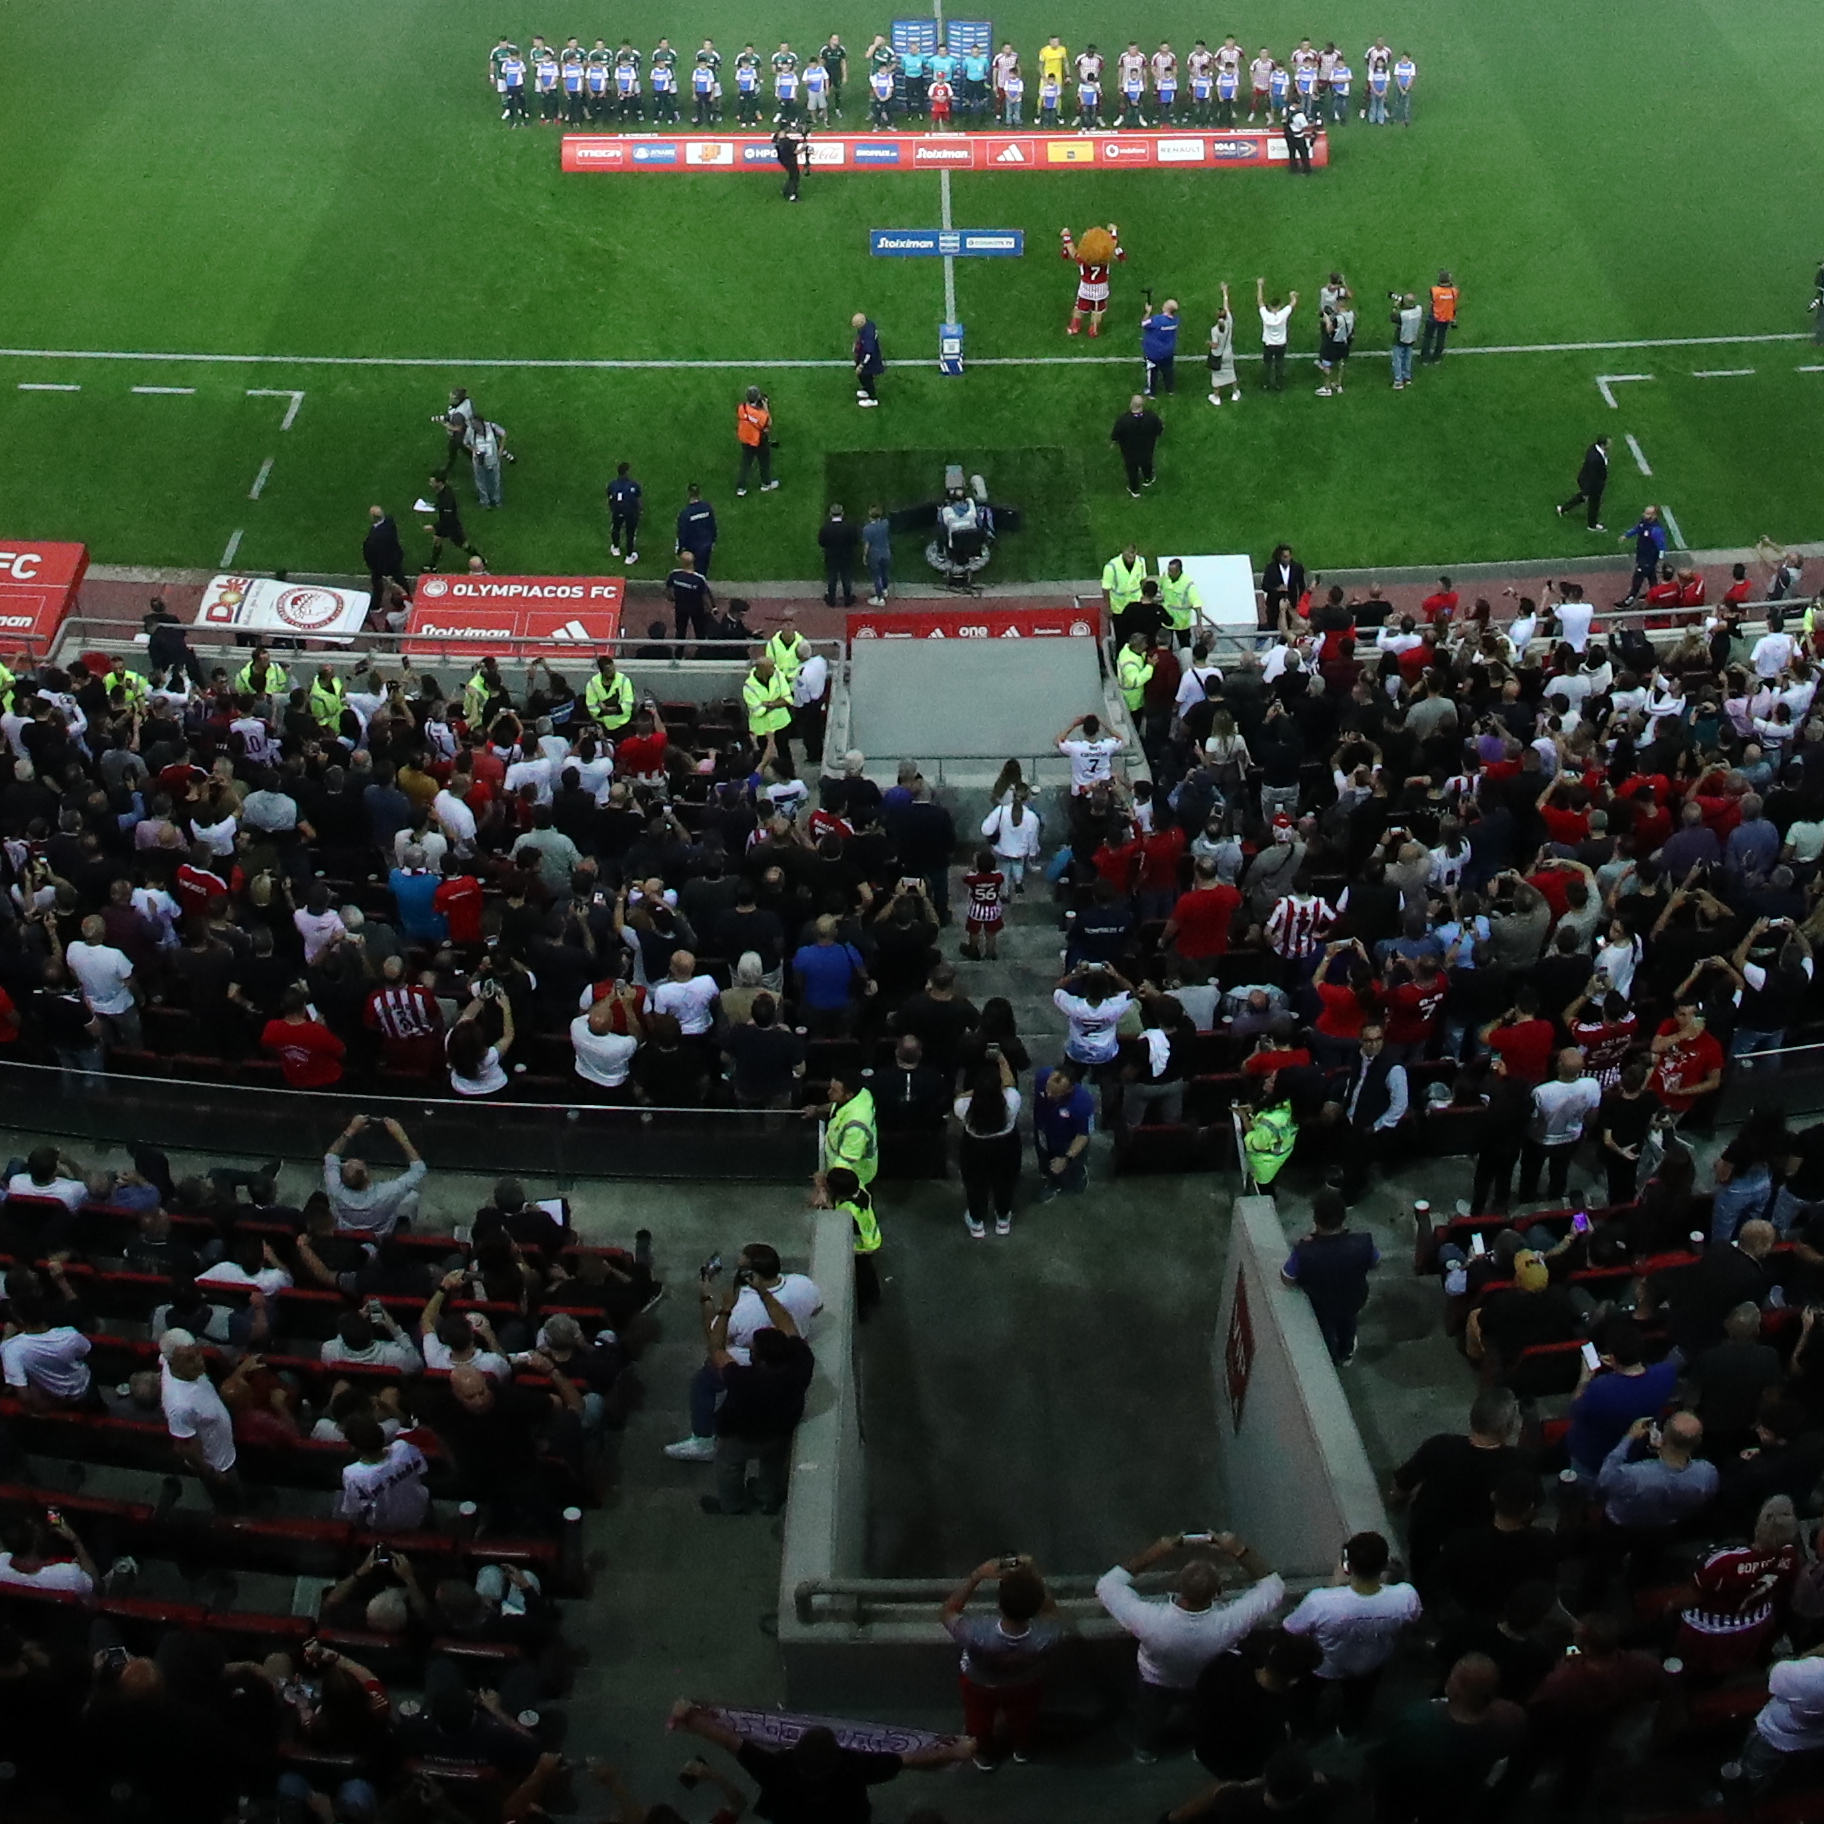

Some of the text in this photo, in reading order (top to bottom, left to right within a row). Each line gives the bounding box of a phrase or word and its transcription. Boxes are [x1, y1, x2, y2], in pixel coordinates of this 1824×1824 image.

[916, 148, 971, 160] Stoiximan
[877, 237, 934, 249] Stoiximan
[1090, 266, 1101, 281] 7
[452, 584, 617, 599] OLYMPIACOS FC
[420, 624, 511, 638] Stoiximan
[959, 626, 988, 638] one
[1087, 759, 1099, 773] 7
[975, 889, 997, 901] 56
[1740, 1573, 1779, 1611] 7
